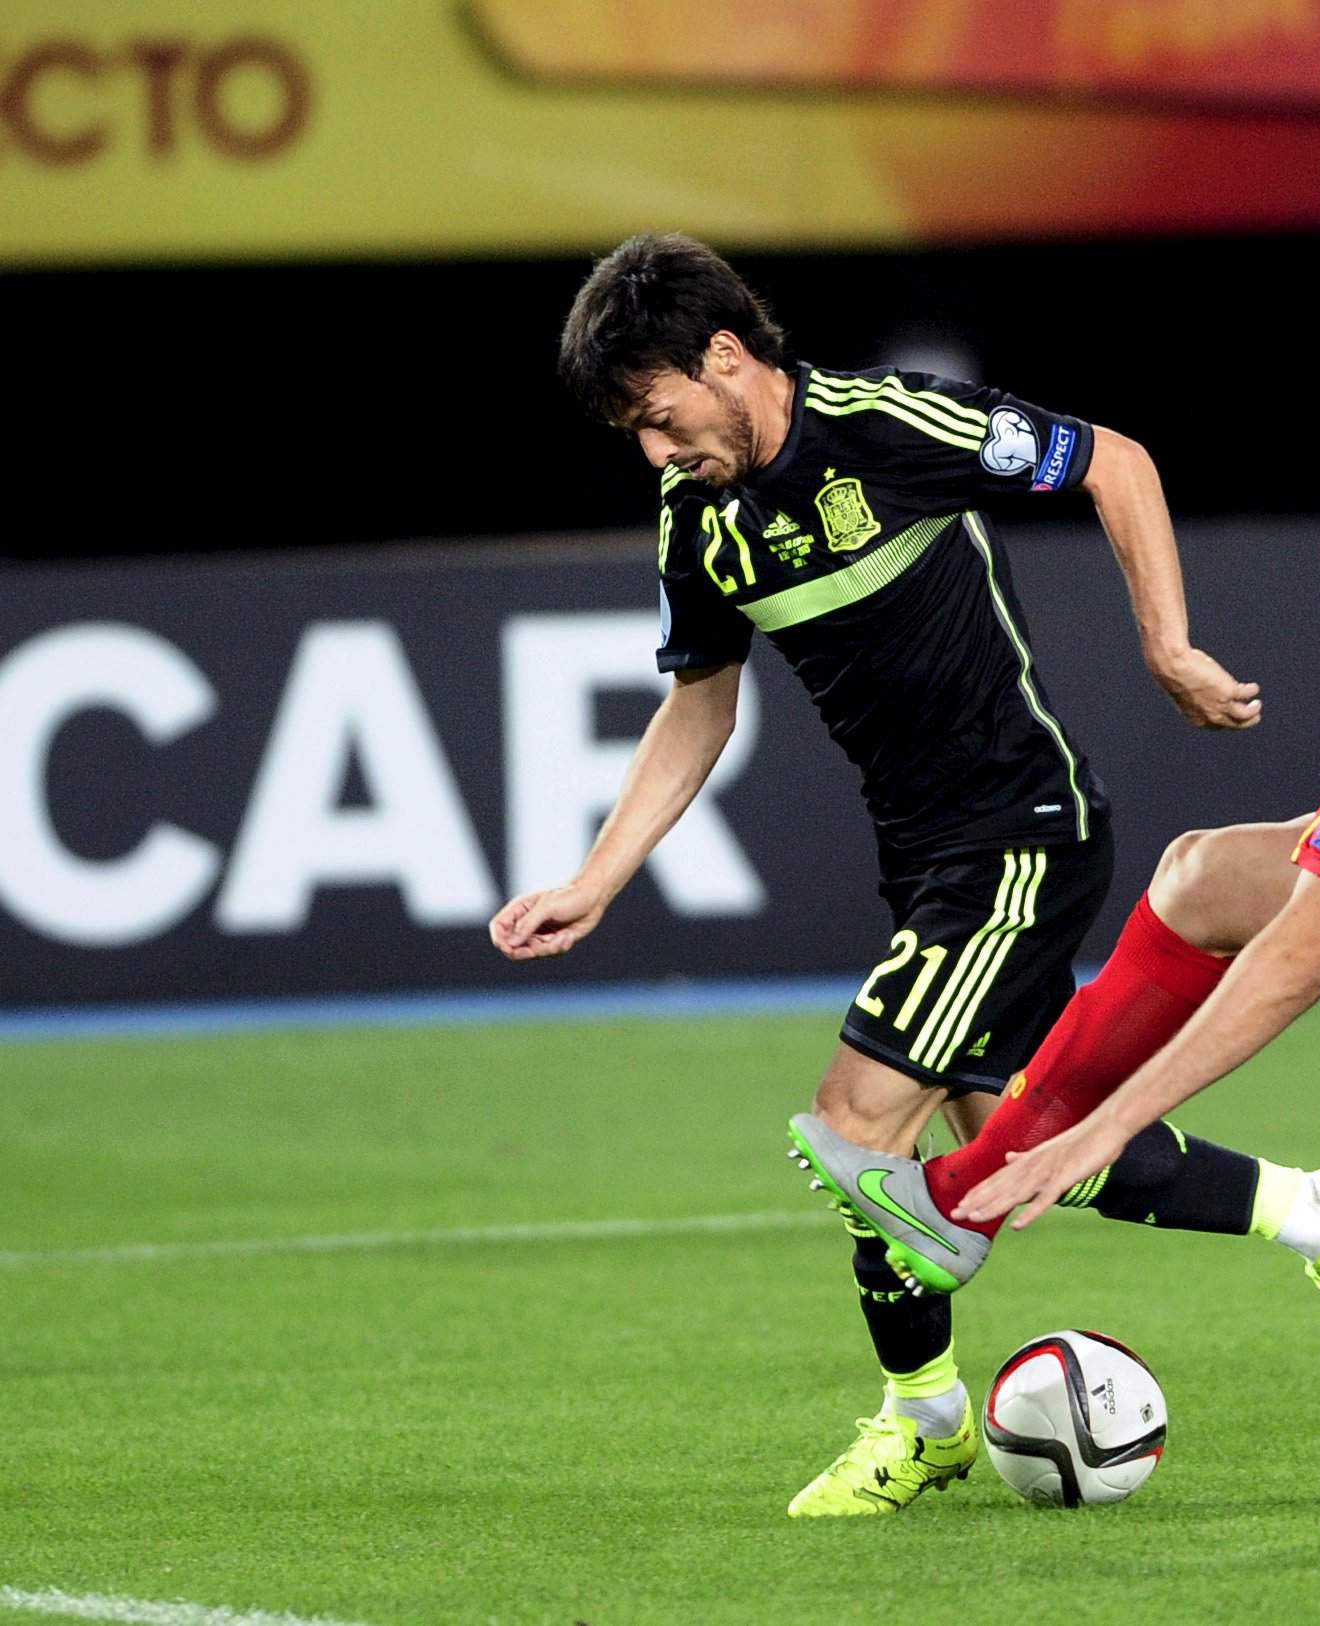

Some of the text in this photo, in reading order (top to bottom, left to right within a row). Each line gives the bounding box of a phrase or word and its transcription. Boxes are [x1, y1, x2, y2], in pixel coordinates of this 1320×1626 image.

[1043, 426, 1071, 485] RESPECT
[701, 499, 757, 595] 21
[0, 618, 770, 948] CAR
[855, 928, 948, 1032] 21
